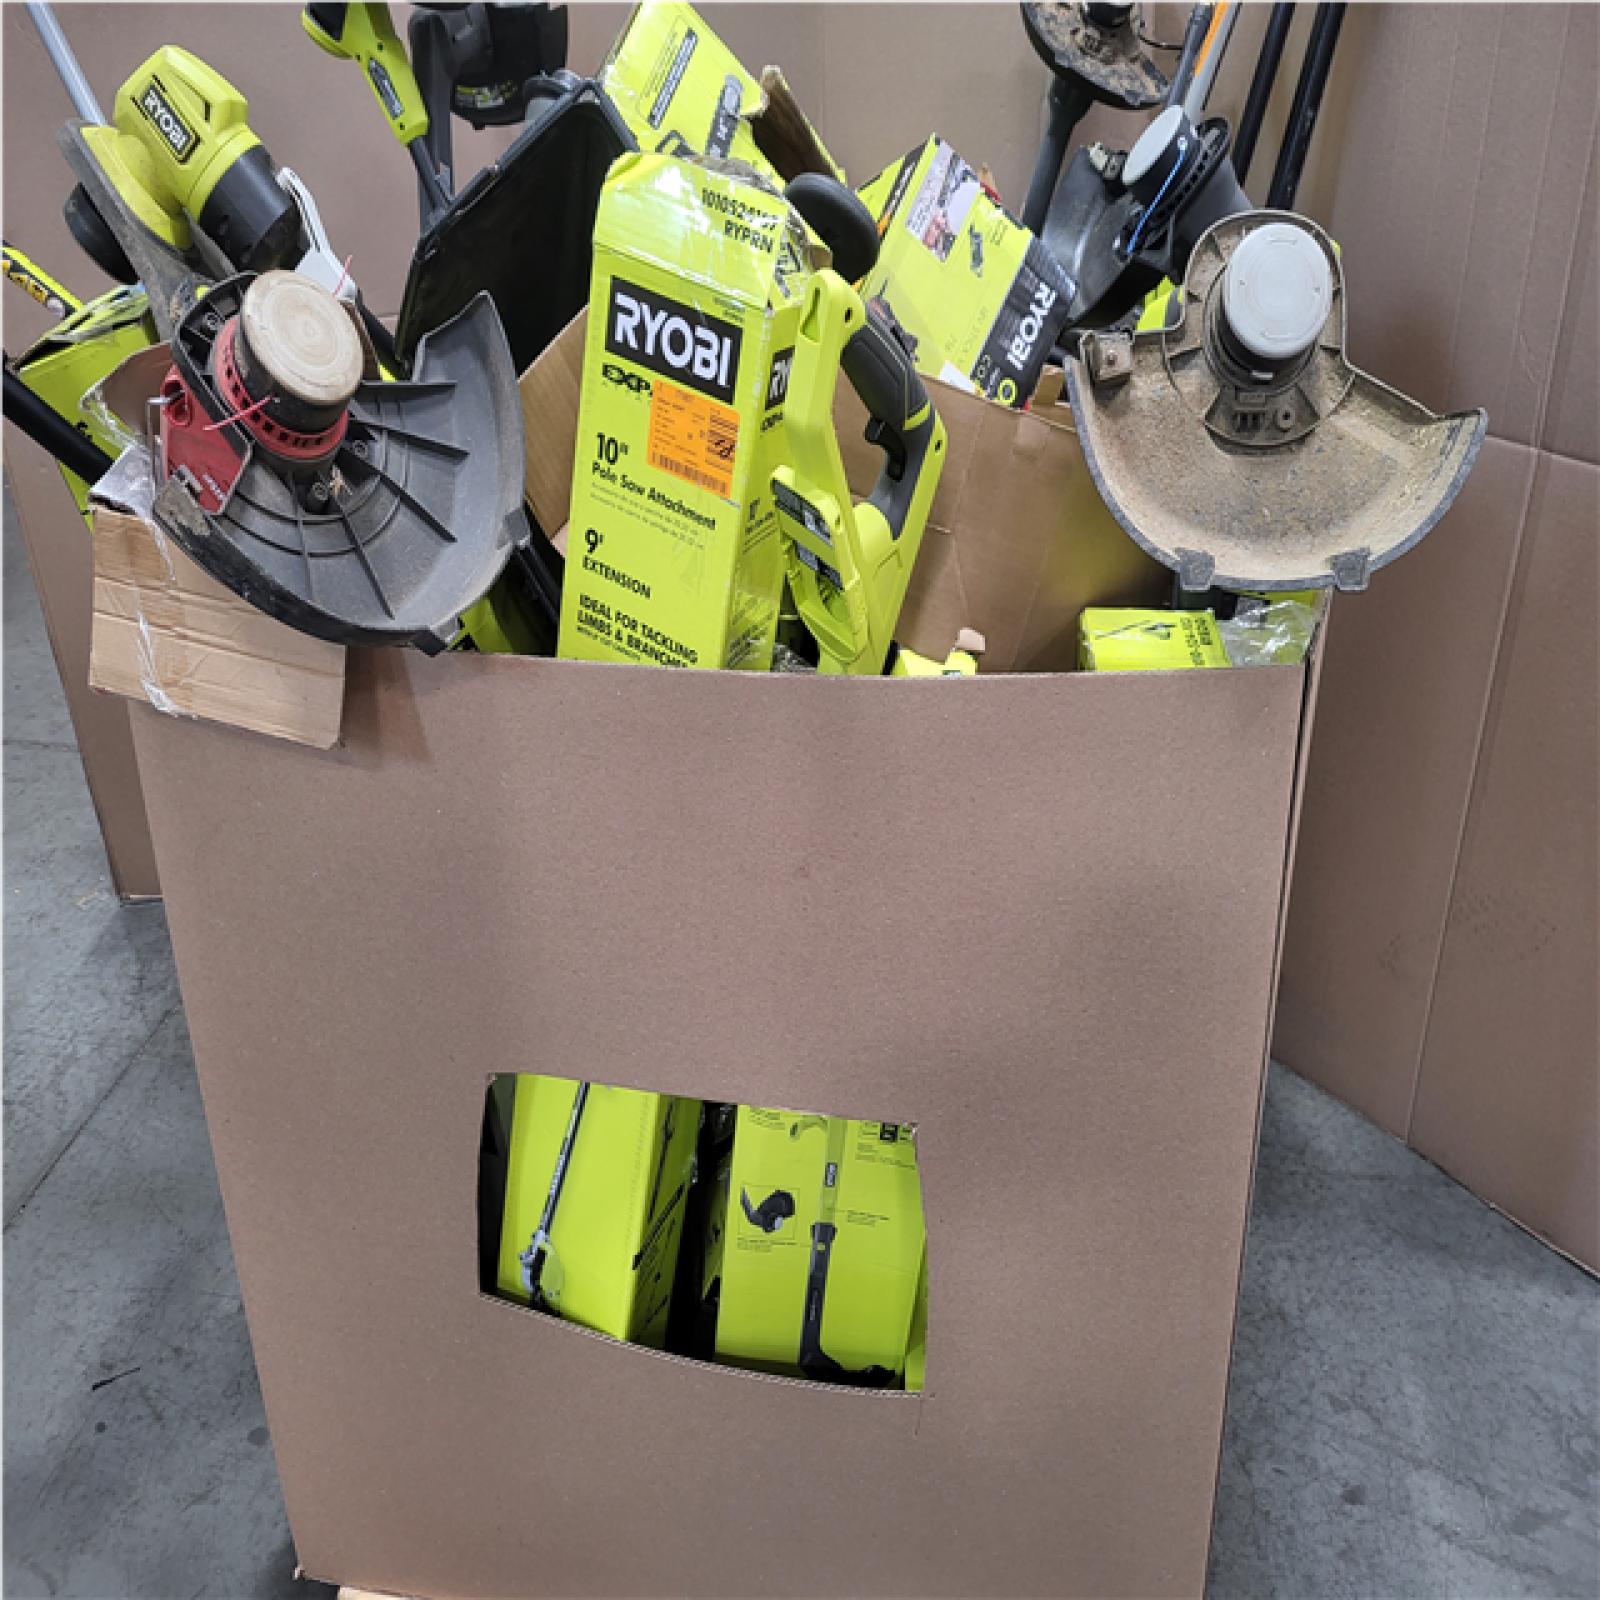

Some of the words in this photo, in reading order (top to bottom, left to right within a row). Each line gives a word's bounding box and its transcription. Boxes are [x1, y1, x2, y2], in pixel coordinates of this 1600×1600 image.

[144, 89, 187, 152] RYOBI
[614, 291, 732, 389] RYOBI
[1006, 282, 1057, 371] RYOBI
[597, 431, 629, 465] 10"
[592, 460, 618, 484] Pole
[620, 474, 646, 495] Saw
[647, 487, 716, 531] Attachment
[584, 528, 604, 554] 9'
[582, 554, 650, 600] EXTENSION
[577, 608, 611, 636] LIMBS
[579, 593, 612, 621] IDEAL
[614, 609, 638, 633] FOR
[641, 622, 698, 664] TACKLING
